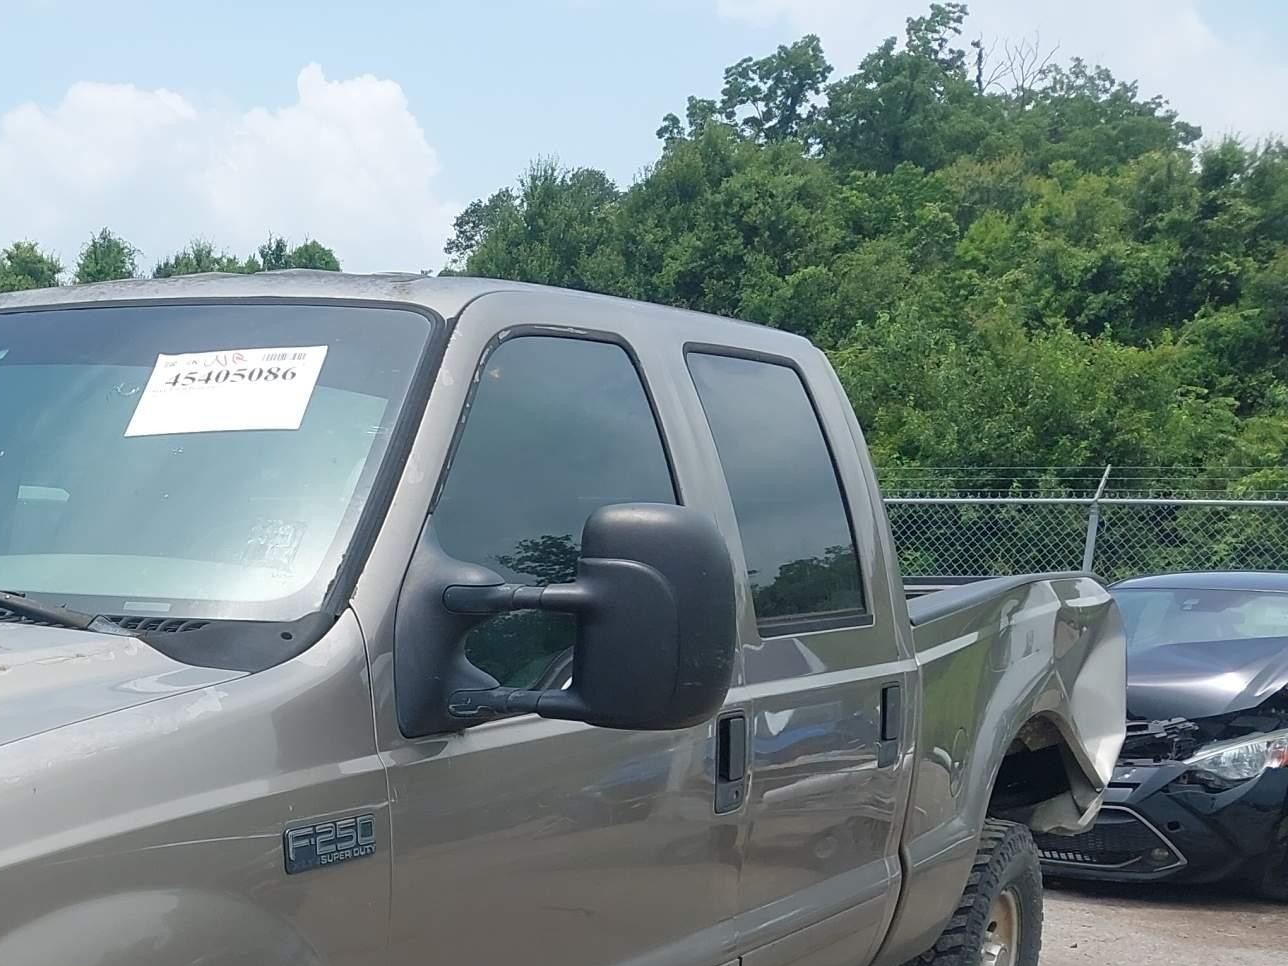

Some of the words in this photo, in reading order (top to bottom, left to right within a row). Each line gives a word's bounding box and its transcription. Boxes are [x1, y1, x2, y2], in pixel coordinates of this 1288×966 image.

[165, 366, 297, 388] 45405086
[320, 849, 352, 865] SUPER
[353, 844, 377, 857] DUTY
